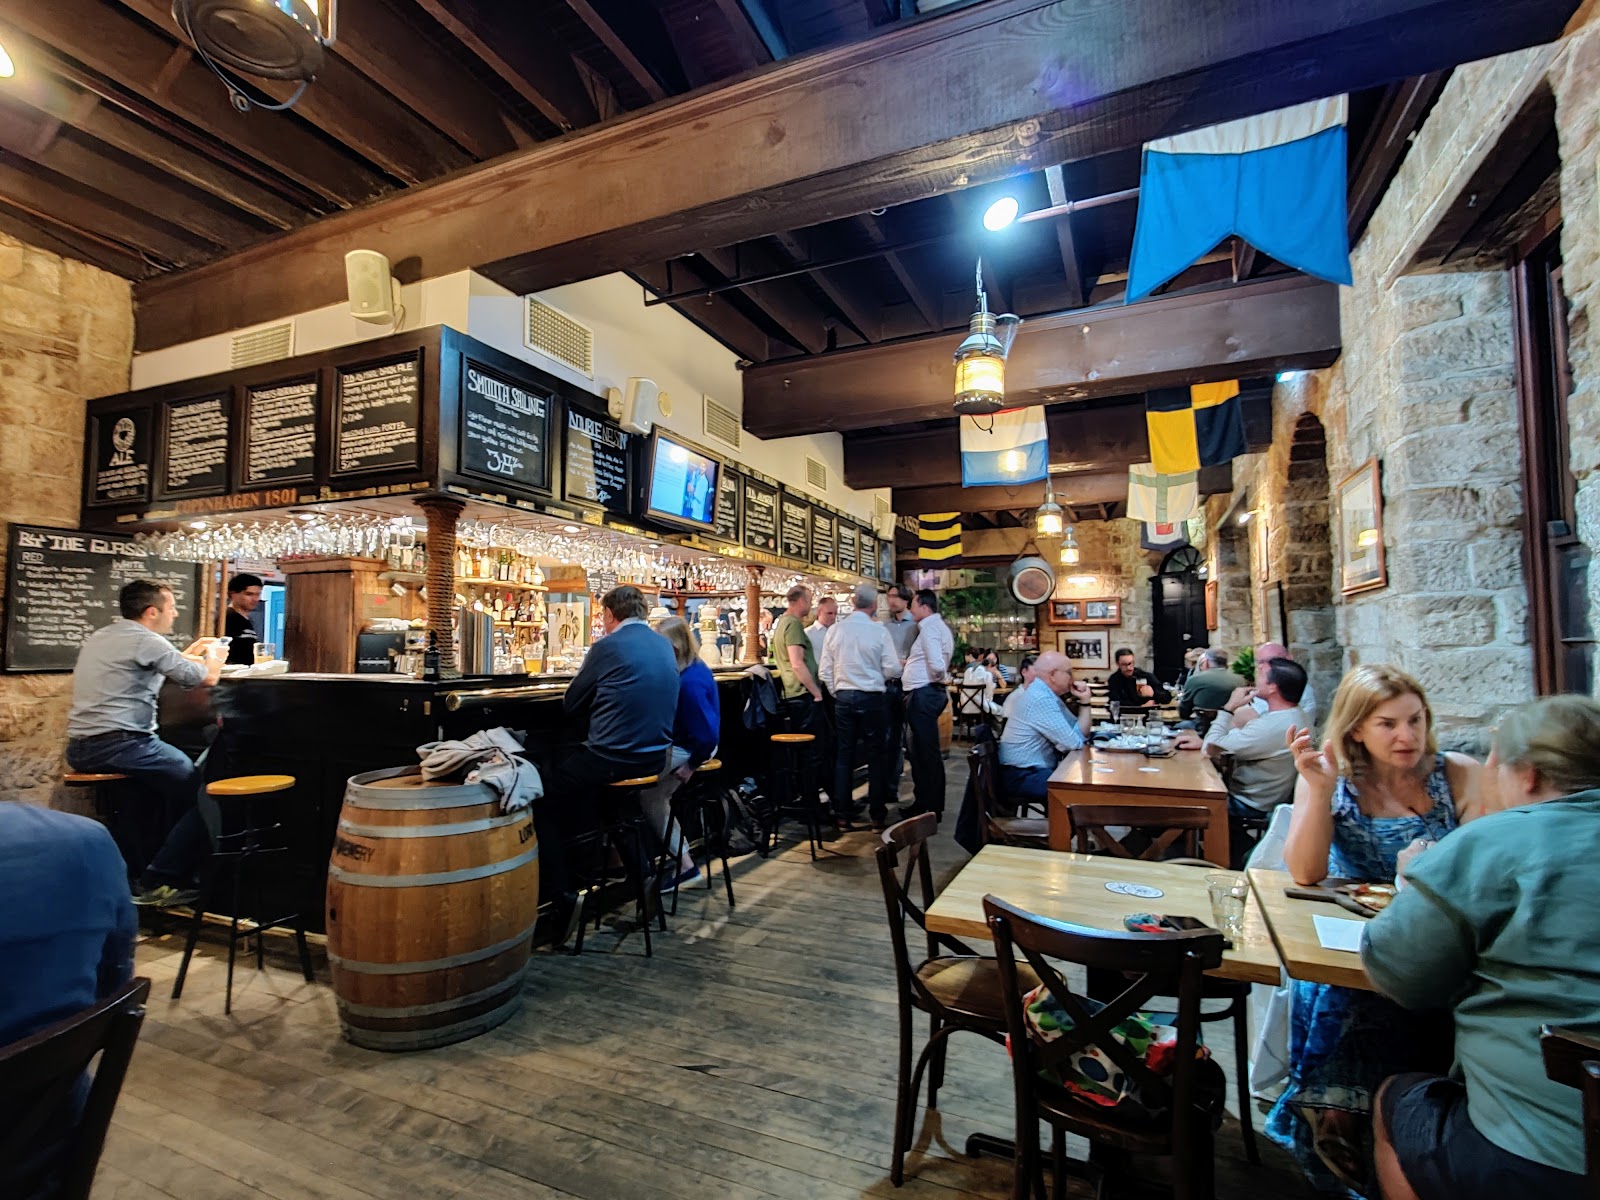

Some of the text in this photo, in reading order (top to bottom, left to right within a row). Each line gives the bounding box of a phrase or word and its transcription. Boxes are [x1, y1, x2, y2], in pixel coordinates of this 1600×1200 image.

[468, 369, 546, 418] SMOOTH SAILING
[264, 488, 297, 506] 1801
[18, 530, 148, 557] BY THE GLASS
[22, 552, 44, 561] RED
[112, 559, 145, 569] WHITE
